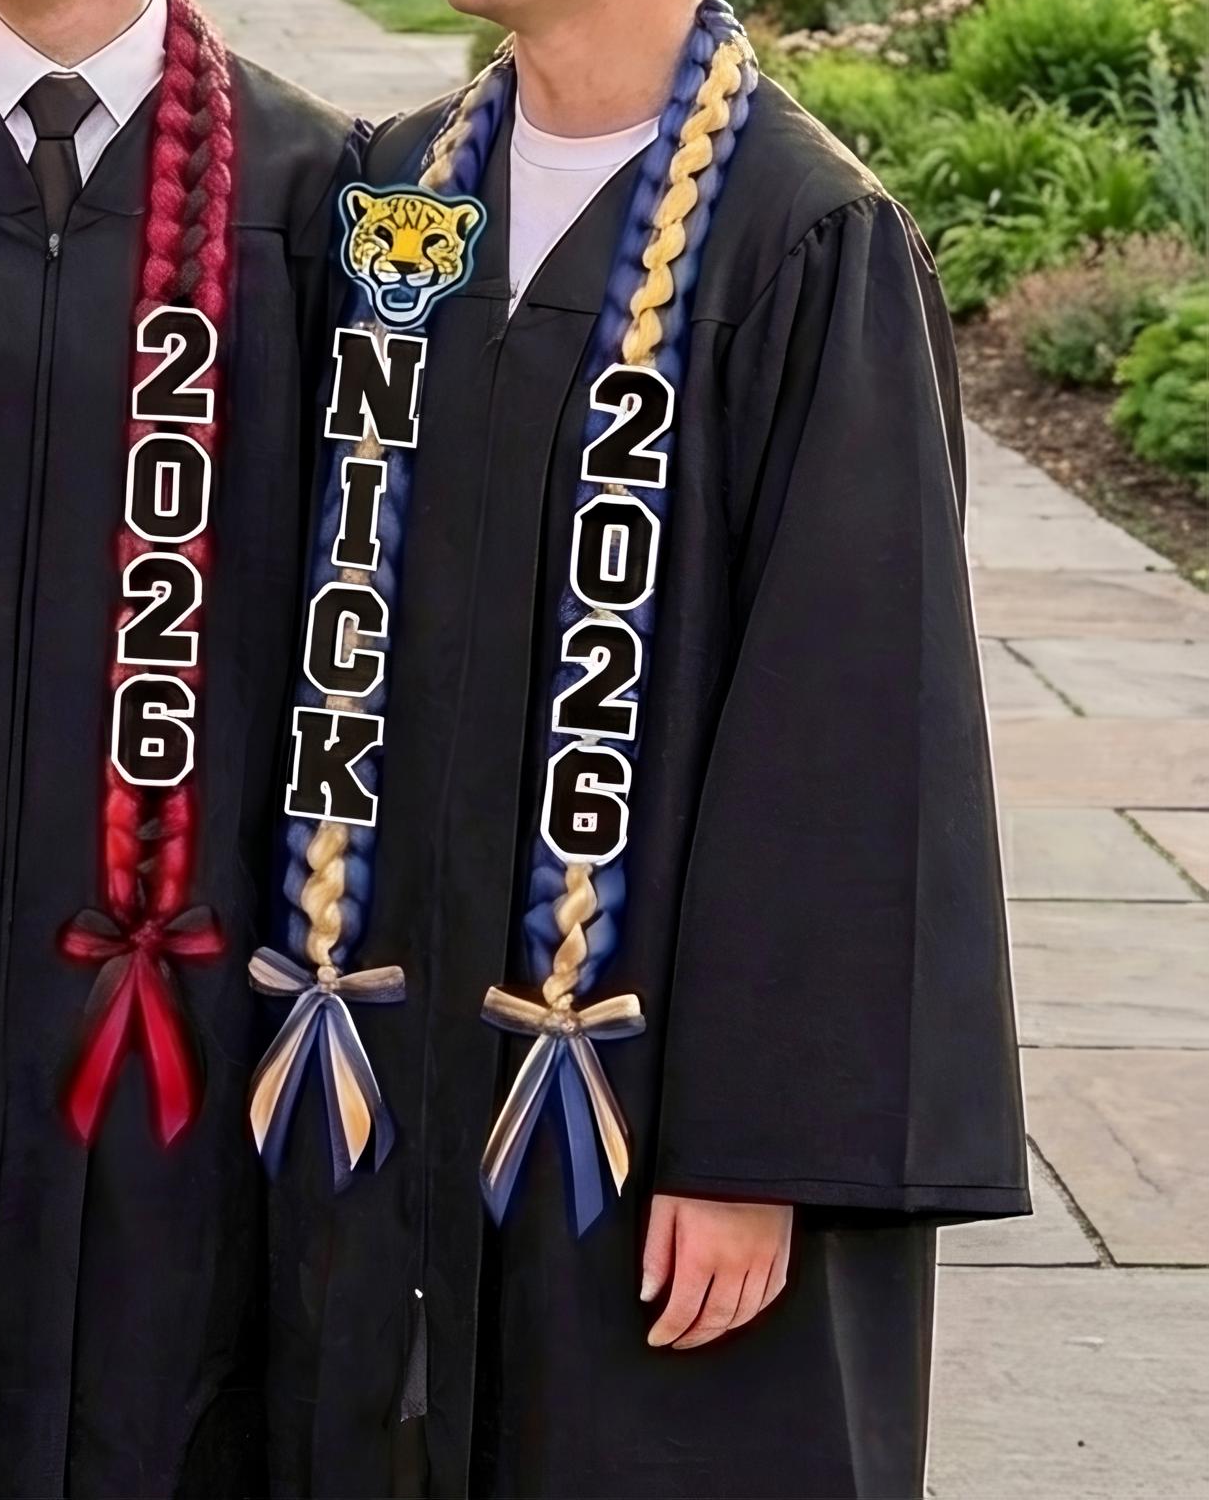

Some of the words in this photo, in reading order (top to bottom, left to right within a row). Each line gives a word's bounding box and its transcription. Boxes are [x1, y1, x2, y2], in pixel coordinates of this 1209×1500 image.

[111, 305, 219, 787] 2026
[284, 327, 428, 827] NICK
[540, 363, 675, 867] 2026
